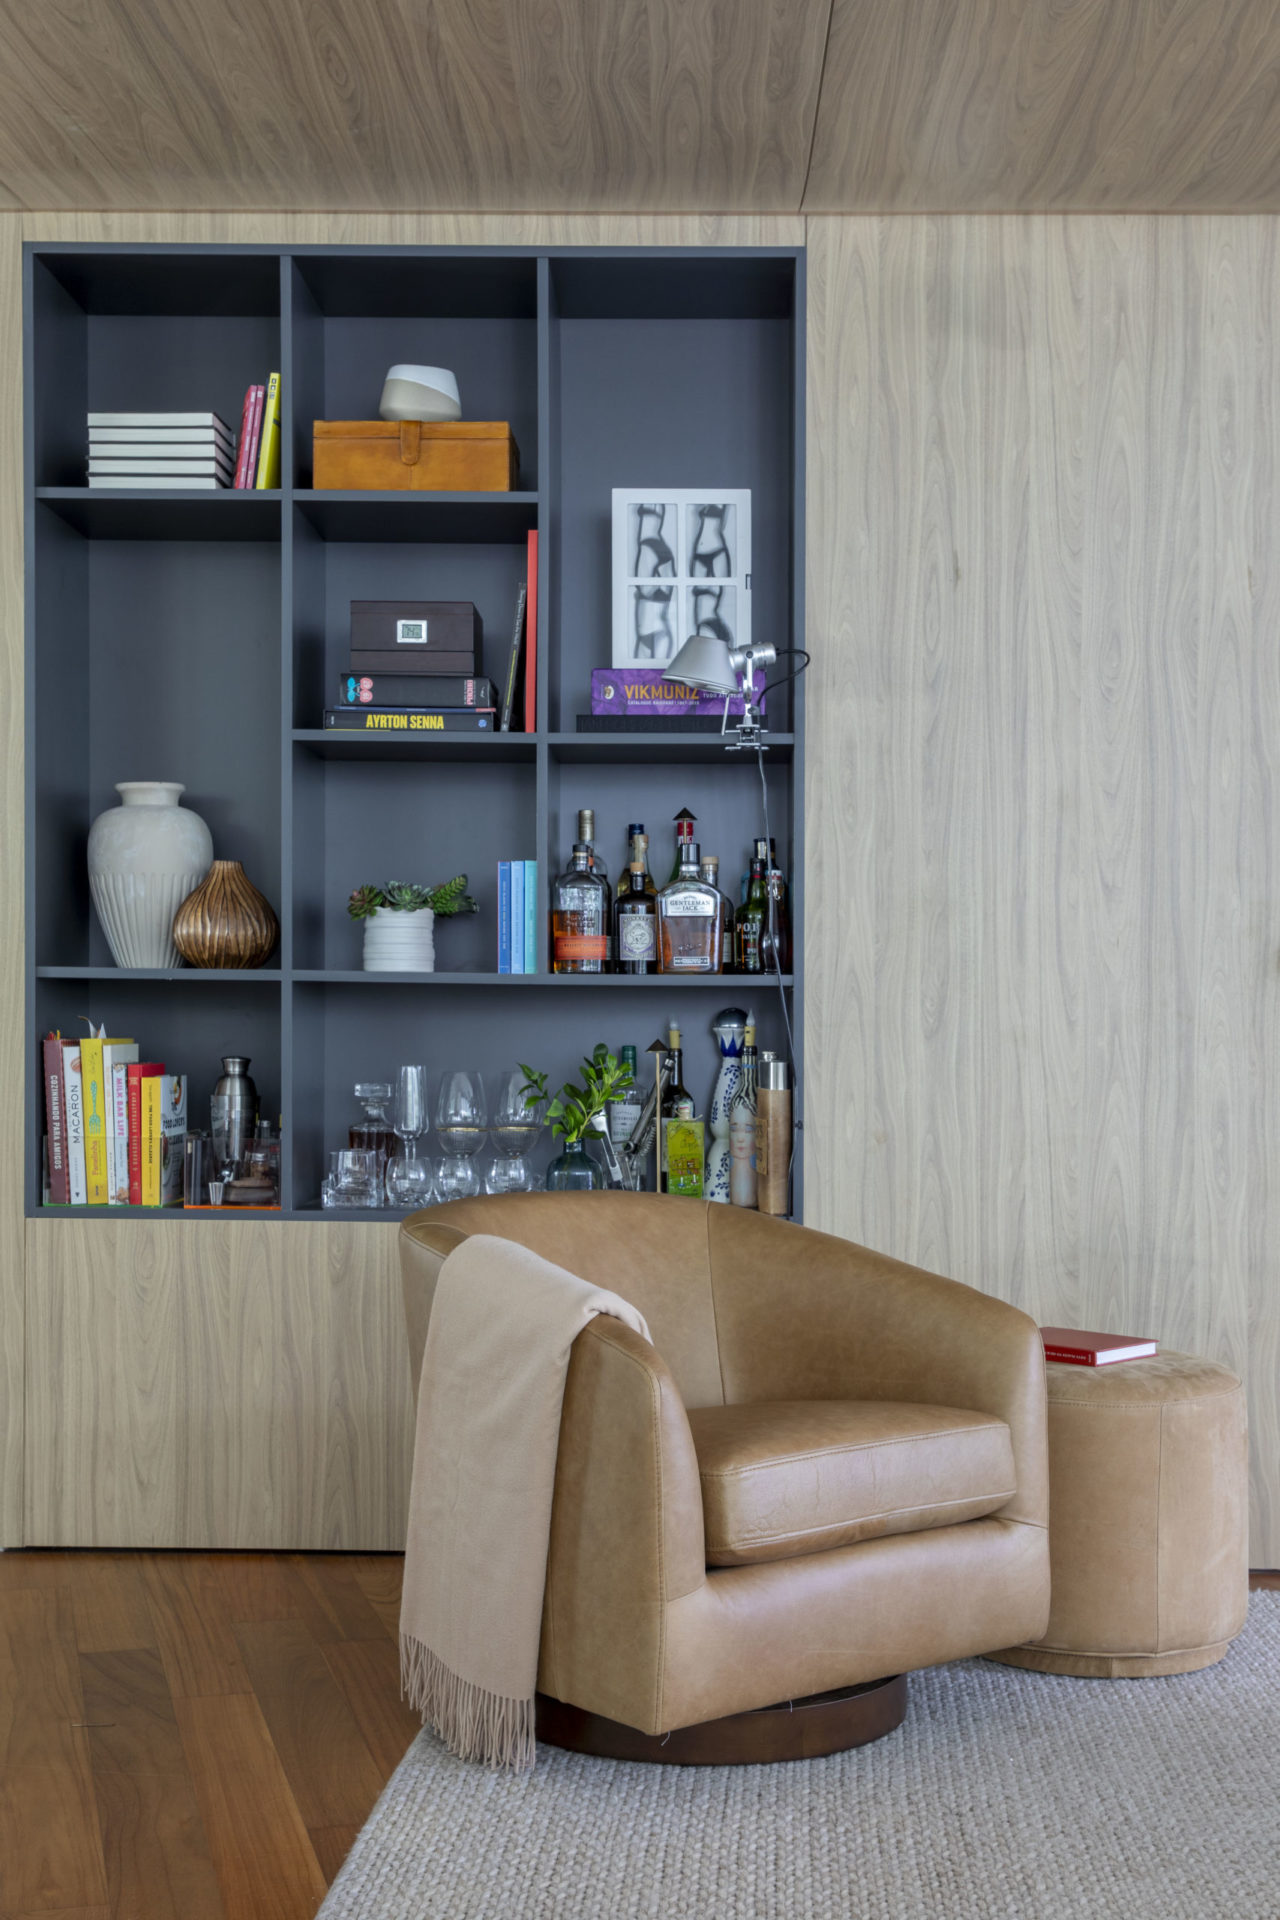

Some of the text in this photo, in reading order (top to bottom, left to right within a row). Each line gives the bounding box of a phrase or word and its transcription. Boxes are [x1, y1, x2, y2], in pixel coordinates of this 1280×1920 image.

[366, 714, 445, 730] AYRTON SENNA
[72, 1084, 81, 1144] MACARON
[116, 1101, 124, 1117] BAR
[50, 1075, 62, 1170] COZINHANDO PARA AMIGOS
[117, 1119, 125, 1137] LIFE
